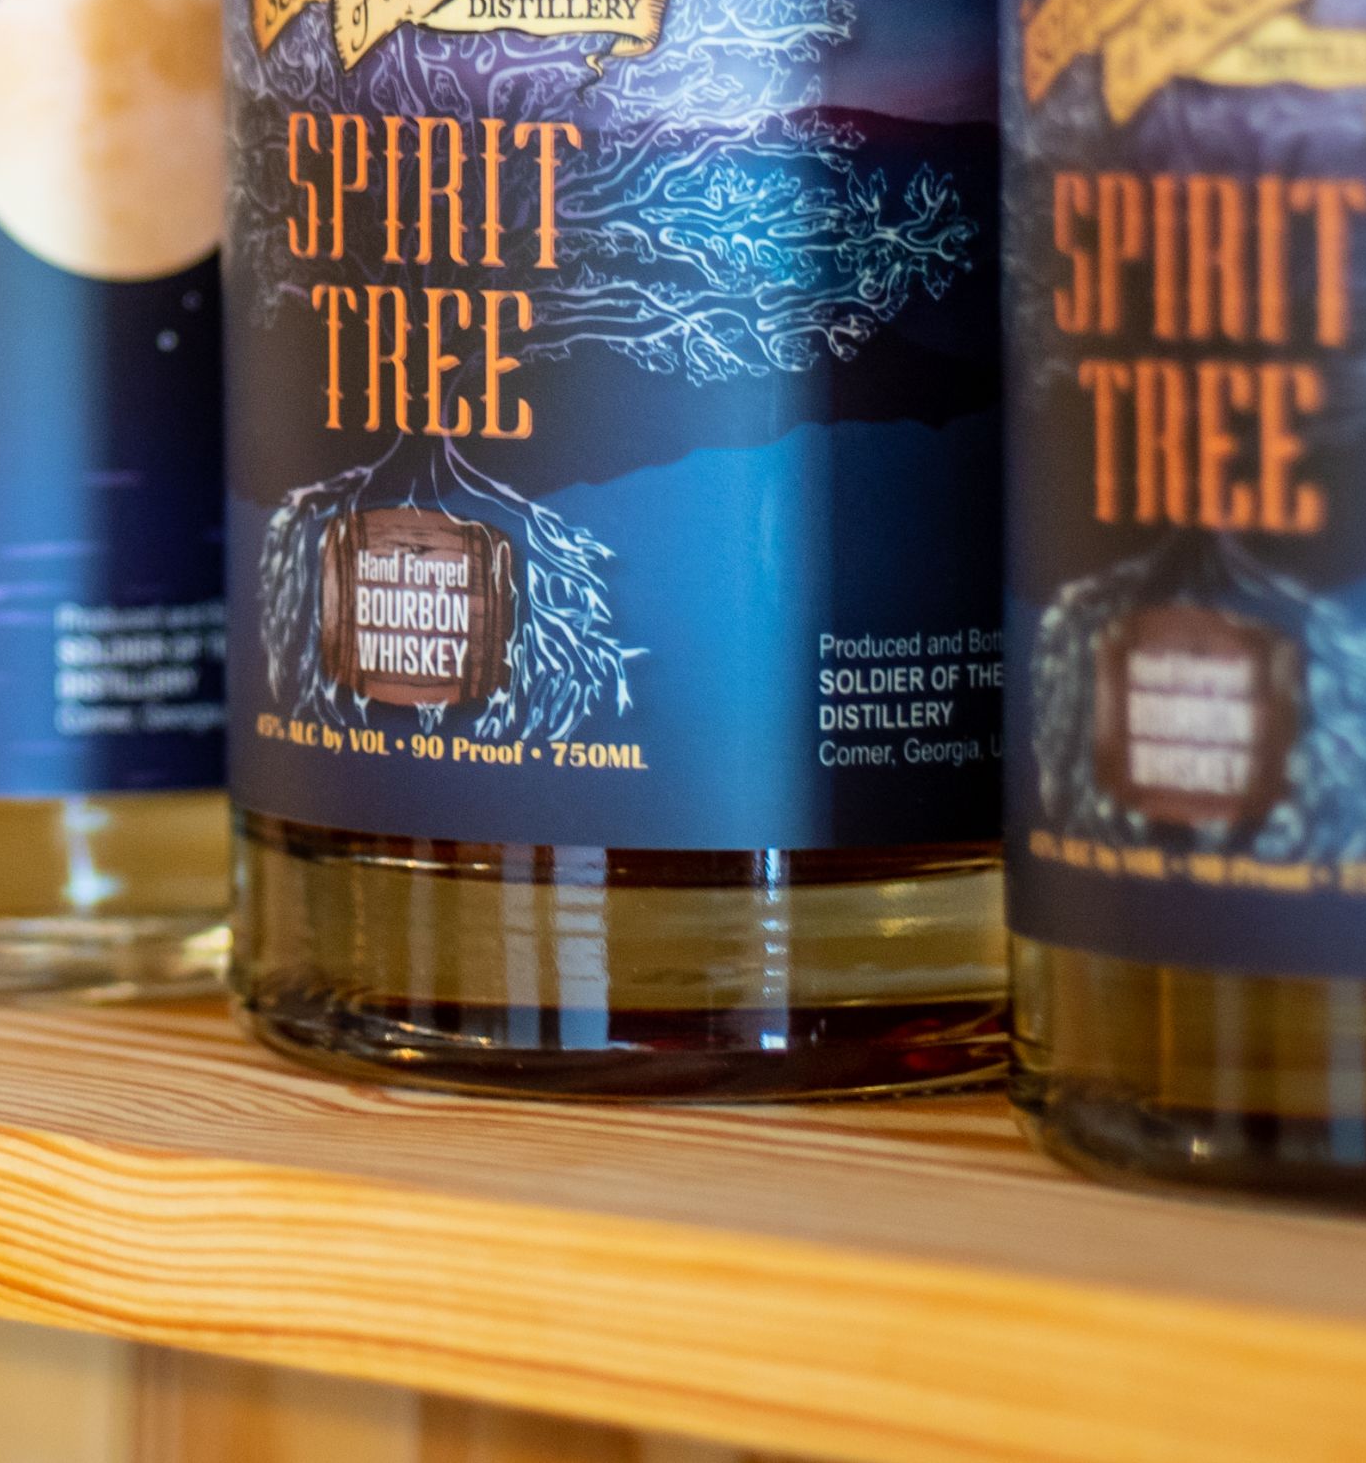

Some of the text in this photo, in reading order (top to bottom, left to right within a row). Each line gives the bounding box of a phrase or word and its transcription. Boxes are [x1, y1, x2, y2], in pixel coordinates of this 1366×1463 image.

[286, 111, 582, 270] SPIRIT
[311, 284, 534, 440] TREE
[1077, 359, 1326, 534] TREE
[357, 547, 469, 595] Hand Forged
[356, 585, 469, 633] BOURBON
[357, 630, 469, 679] WHISKEY
[818, 632, 921, 660] Produced
[927, 629, 963, 656] and
[818, 662, 1004, 695] SOLDIER OF THE
[818, 700, 954, 731] DISTILLERY
[321, 723, 345, 755] by
[348, 727, 391, 756] VOL
[411, 734, 445, 760] 90
[451, 740, 523, 765] Proof
[550, 742, 648, 769] 750ML
